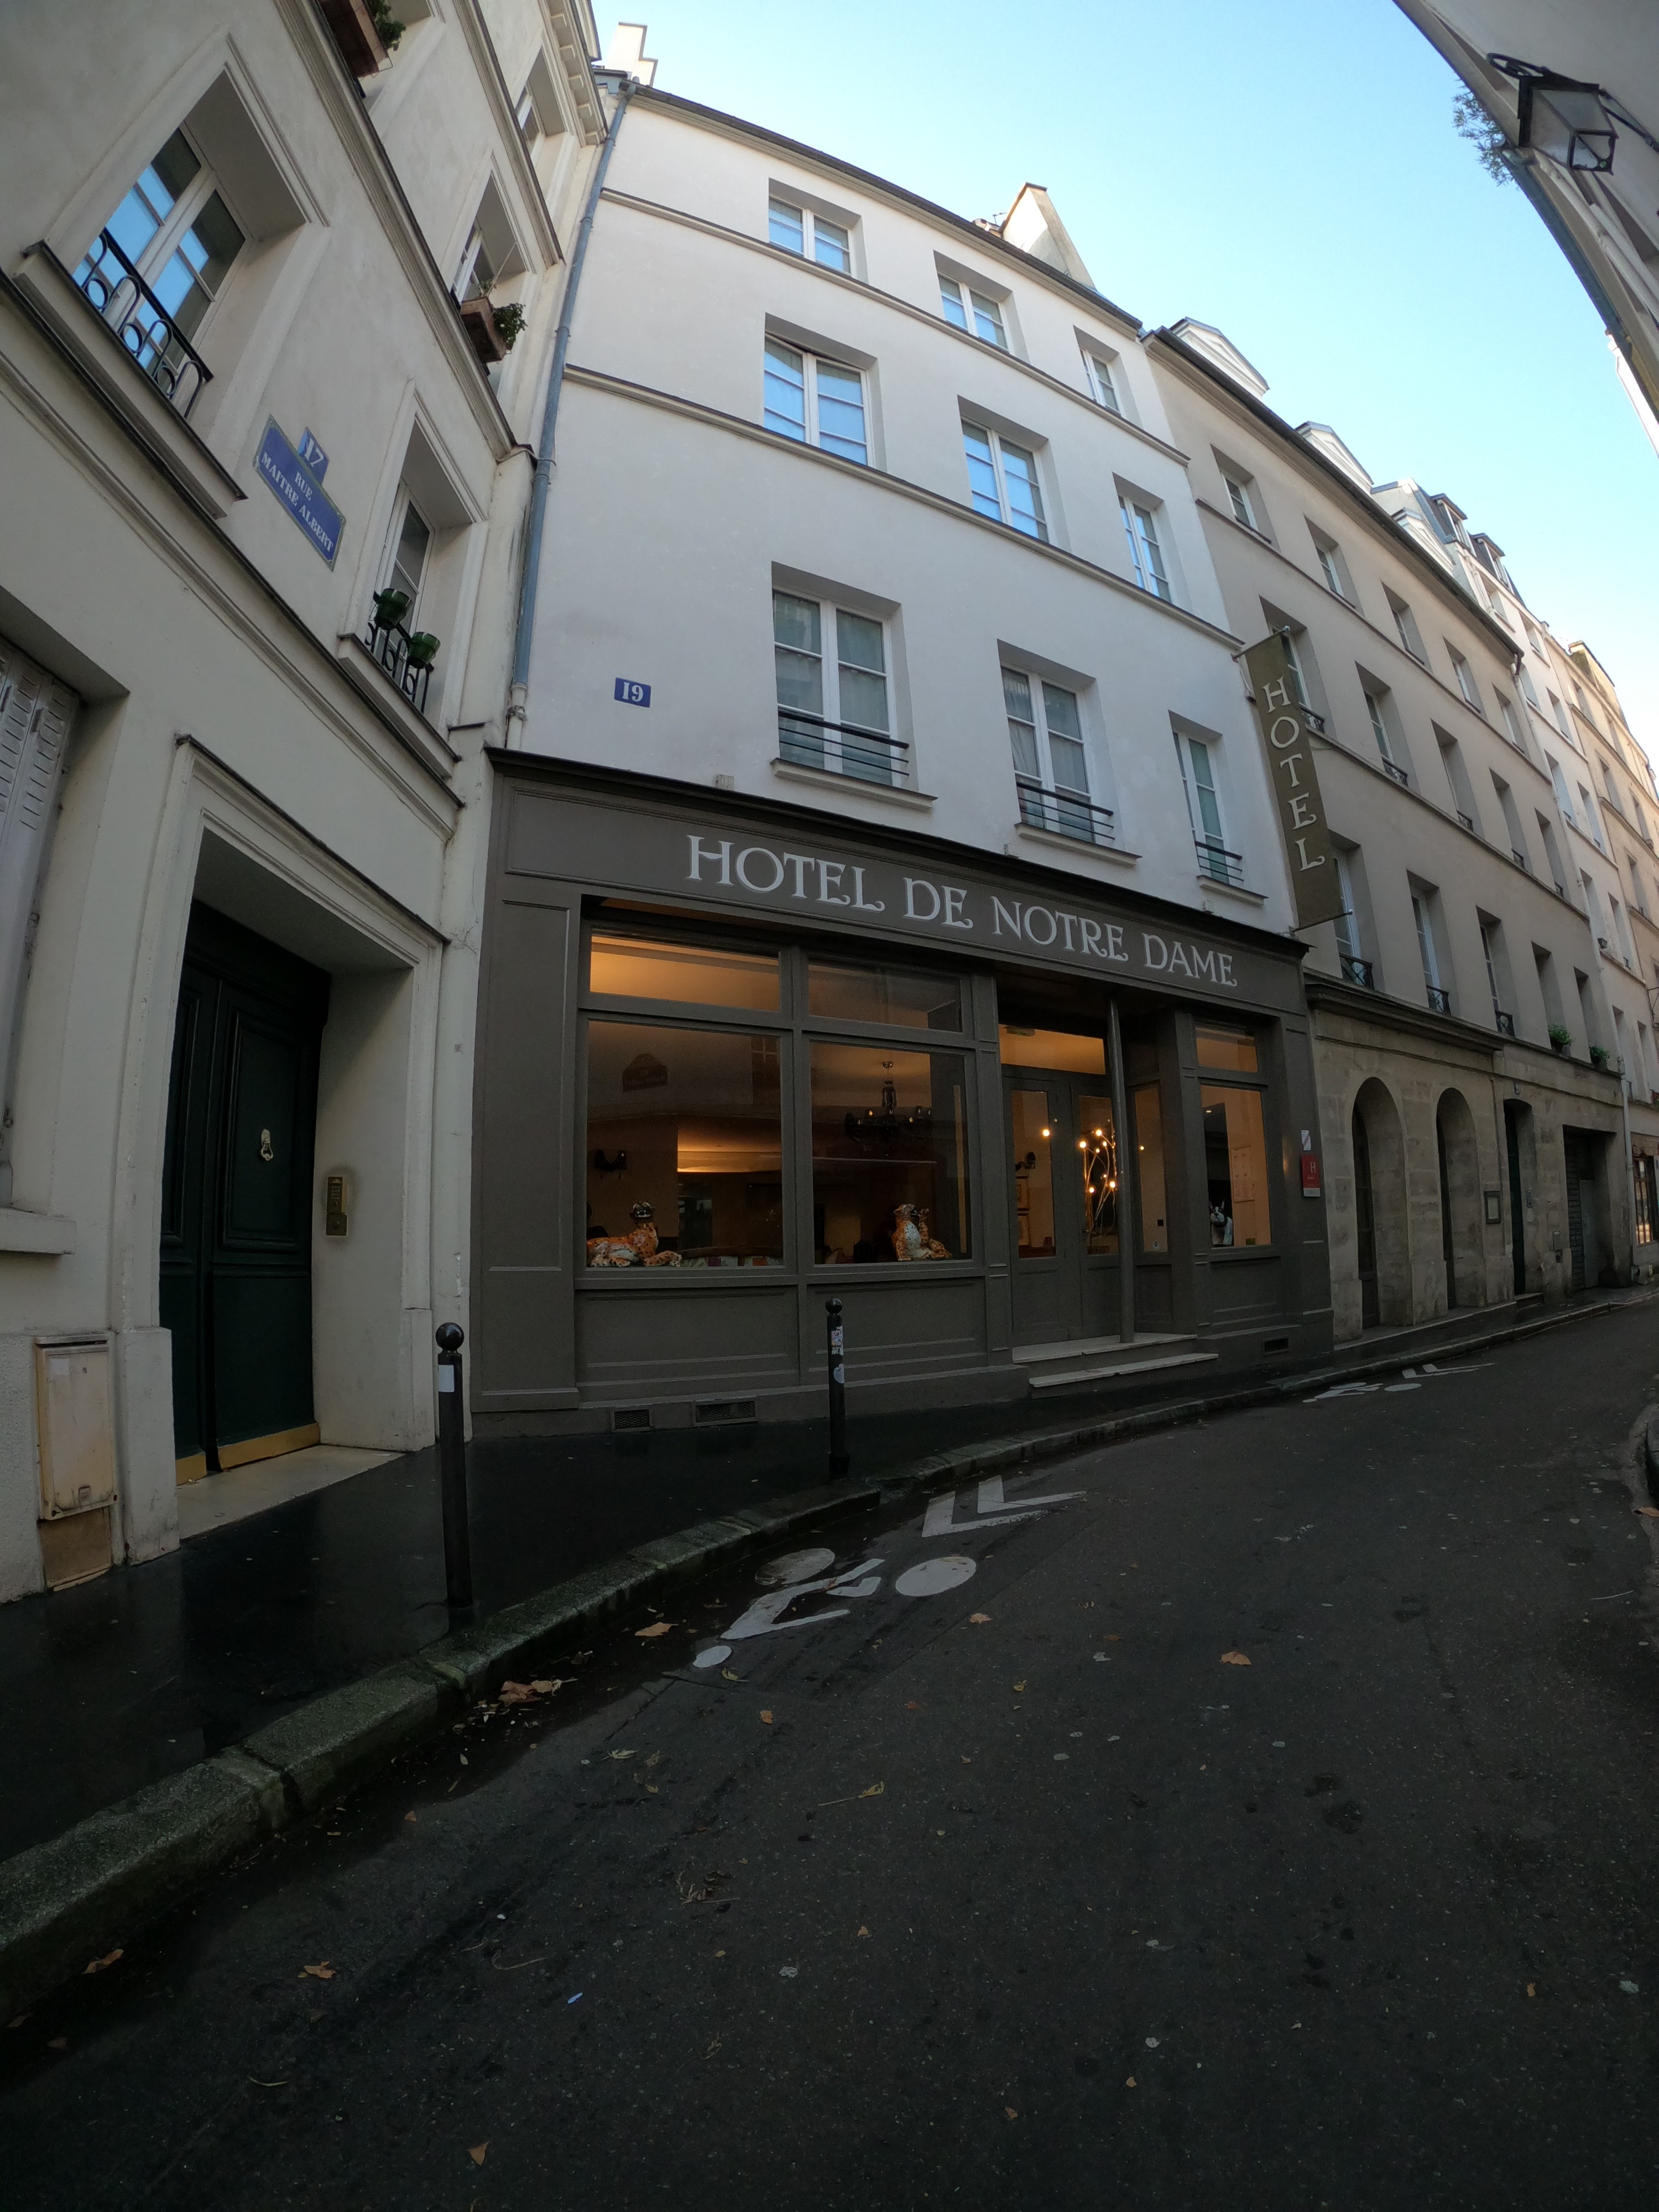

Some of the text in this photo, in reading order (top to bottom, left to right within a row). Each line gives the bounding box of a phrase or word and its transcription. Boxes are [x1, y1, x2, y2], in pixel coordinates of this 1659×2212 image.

[304, 439, 324, 467] 17
[295, 472, 312, 500] RUE
[299, 505, 333, 552] ALBERT
[622, 682, 644, 702] 19
[1262, 676, 1325, 872] HOTEL
[685, 834, 1238, 987] HOTEL DE NOTRE DAME
[1310, 1162, 1316, 1173] H
